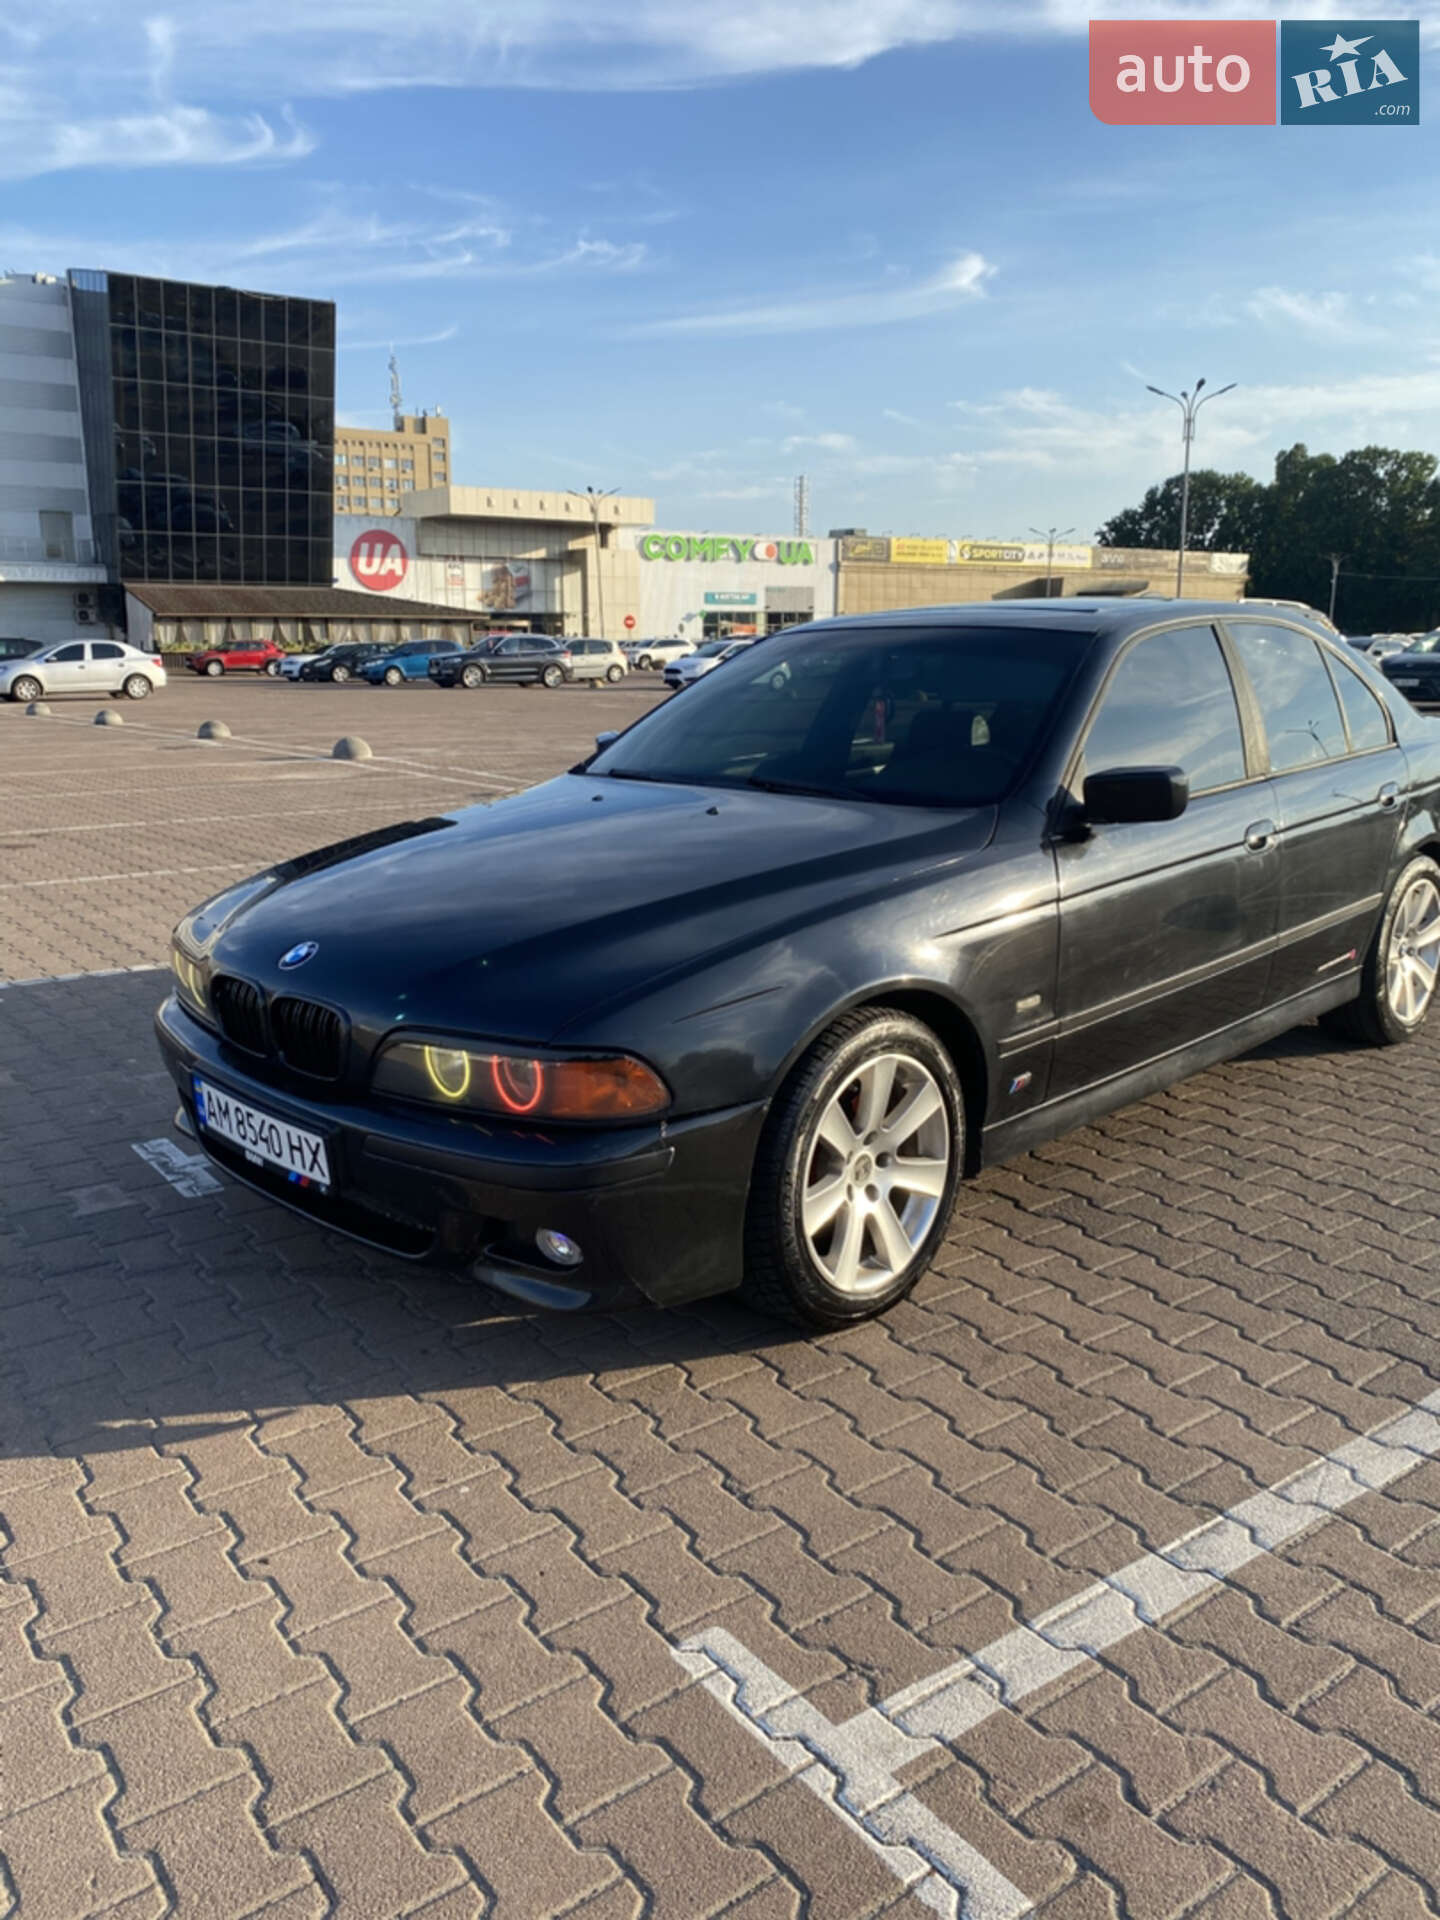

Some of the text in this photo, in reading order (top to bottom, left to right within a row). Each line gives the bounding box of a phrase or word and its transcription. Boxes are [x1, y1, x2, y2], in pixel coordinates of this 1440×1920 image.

[357, 542, 404, 577] UA
[642, 534, 755, 562] COMFY
[206, 1090, 327, 1178] AM 8540 HX
